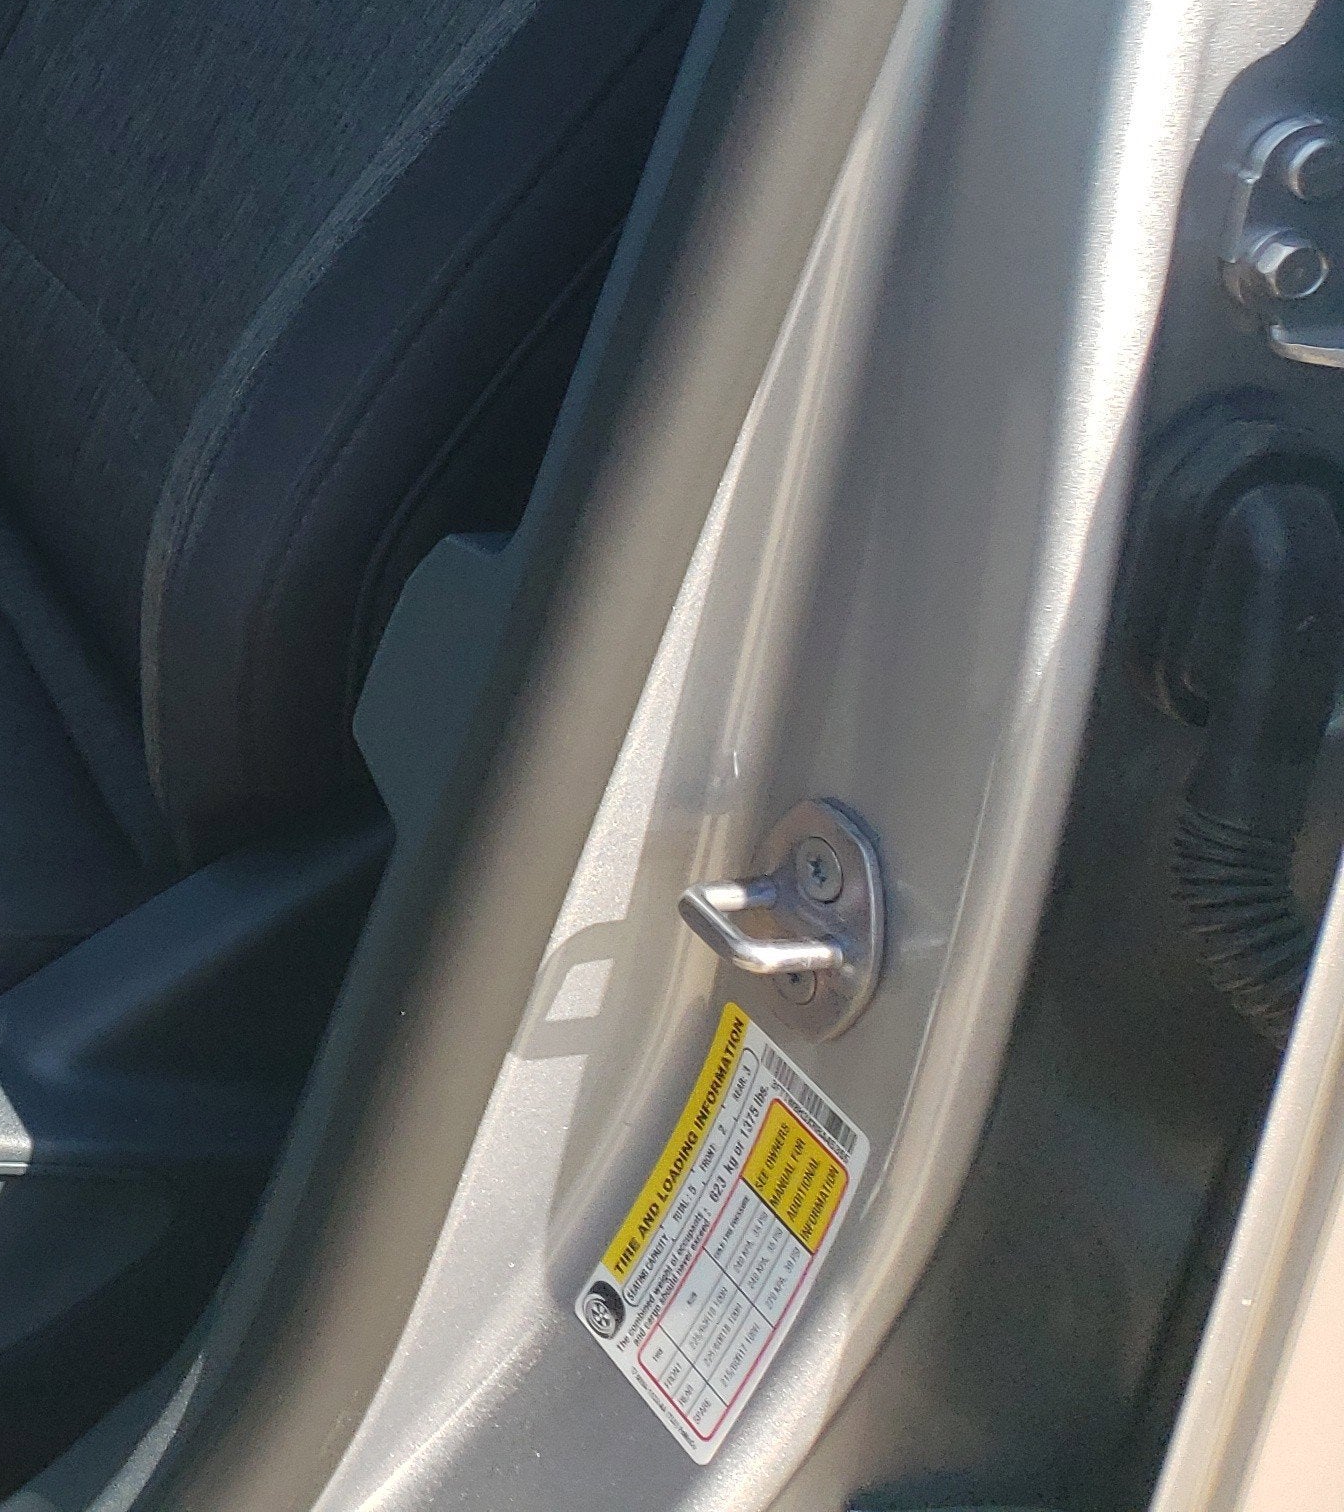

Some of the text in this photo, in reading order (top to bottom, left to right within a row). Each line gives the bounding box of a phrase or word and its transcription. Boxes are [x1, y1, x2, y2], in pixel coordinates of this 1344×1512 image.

[613, 1015, 744, 1277] TIRE AND LOADING INFORMATION
[708, 1080, 769, 1204] 623 kg or 1375 lbs.
[754, 1120, 790, 1192] SEE OWNERS
[769, 1134, 806, 1209] MANUAL FOR
[626, 1266, 649, 1302] SEATING
[643, 1230, 670, 1272] CAPACITY
[717, 1123, 727, 1136] 2
[786, 1155, 820, 1223] ADDITIONAL
[799, 1164, 839, 1242] INFORMATION
[615, 1208, 704, 1353] The combined weight of occupants
[632, 1326, 646, 1347] and
[643, 1302, 662, 1331] cargo
[657, 1271, 679, 1305] should
[675, 1249, 692, 1276] never
[692, 1395, 711, 1425] SPARE
